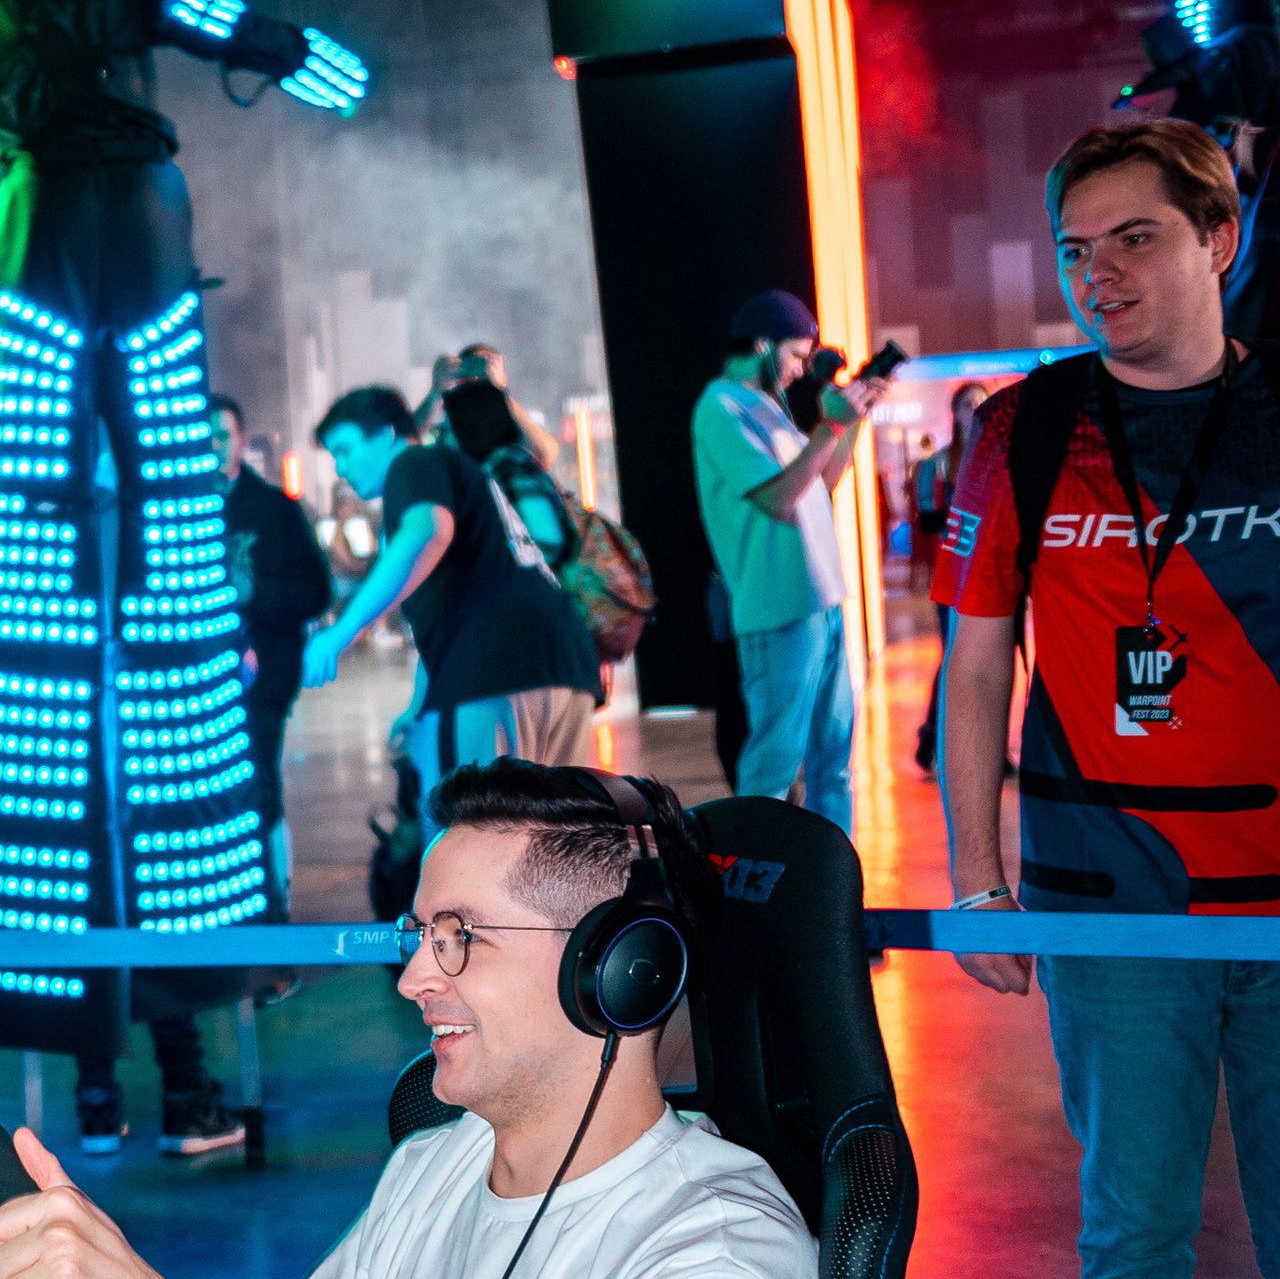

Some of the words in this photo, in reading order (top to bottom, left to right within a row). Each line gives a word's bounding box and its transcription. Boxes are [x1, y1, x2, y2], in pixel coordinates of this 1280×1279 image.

[1127, 651, 1173, 685] VIP
[1129, 695, 1173, 707] WARPOINT
[1132, 710, 1150, 720] FEST
[1150, 709, 1170, 720] 2023
[352, 930, 391, 944] SMP
